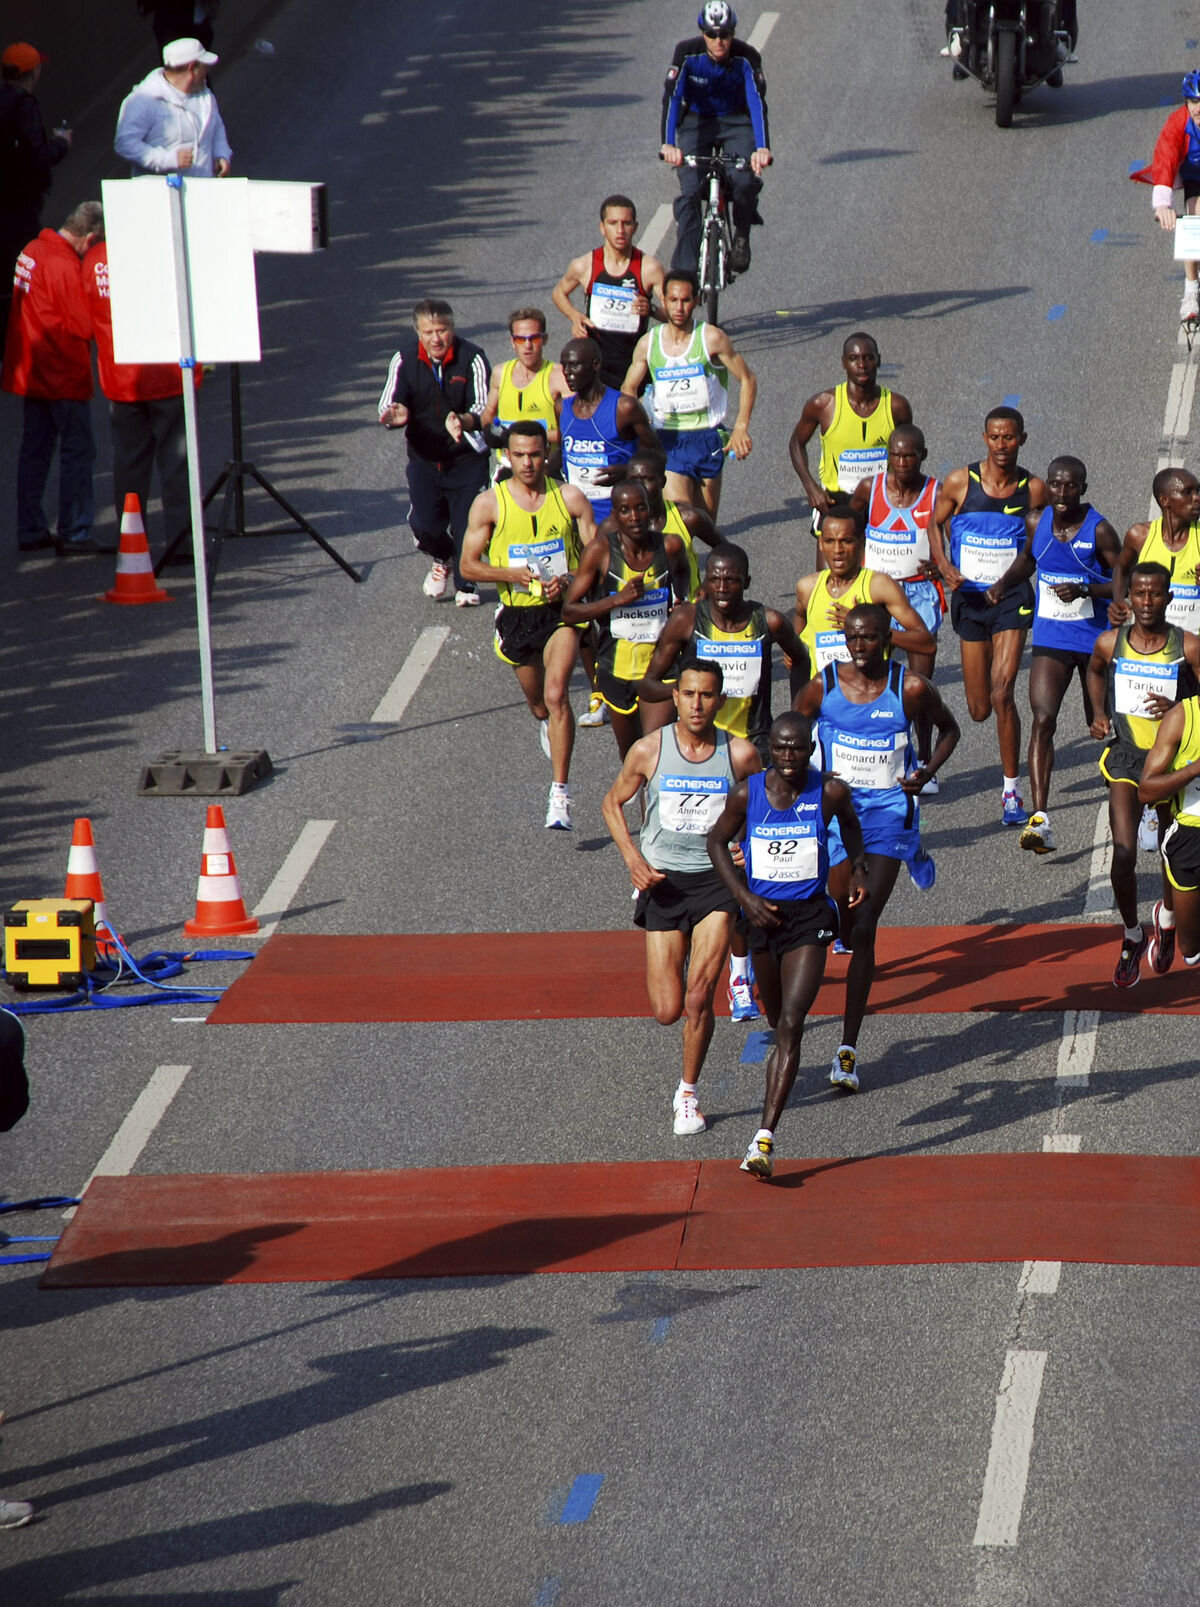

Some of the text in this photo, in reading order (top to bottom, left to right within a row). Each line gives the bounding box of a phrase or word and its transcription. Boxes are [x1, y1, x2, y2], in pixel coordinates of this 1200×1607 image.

[604, 298, 627, 311] 35
[658, 366, 699, 378] CONERGY
[669, 378, 690, 391] 73
[573, 440, 605, 453] asics
[841, 449, 886, 460] CONERGY
[867, 529, 912, 541] CONERGY
[966, 535, 1013, 546] CONERGY
[868, 543, 913, 556] Kiprotich
[616, 608, 664, 620] Jackson
[703, 644, 757, 654] CONERGY
[820, 651, 851, 661] Tesse
[721, 661, 748, 671] avid
[1121, 662, 1172, 676] CONERGY
[1128, 679, 1164, 693] Tariku
[838, 733, 890, 748] CONERGY
[835, 747, 876, 764] Leonard
[666, 779, 722, 790] CONERGY
[679, 793, 710, 807] 77
[677, 807, 708, 816] Ahmed
[755, 825, 810, 837] CONERGY
[767, 840, 798, 855] 82
[773, 855, 793, 863] Paul
